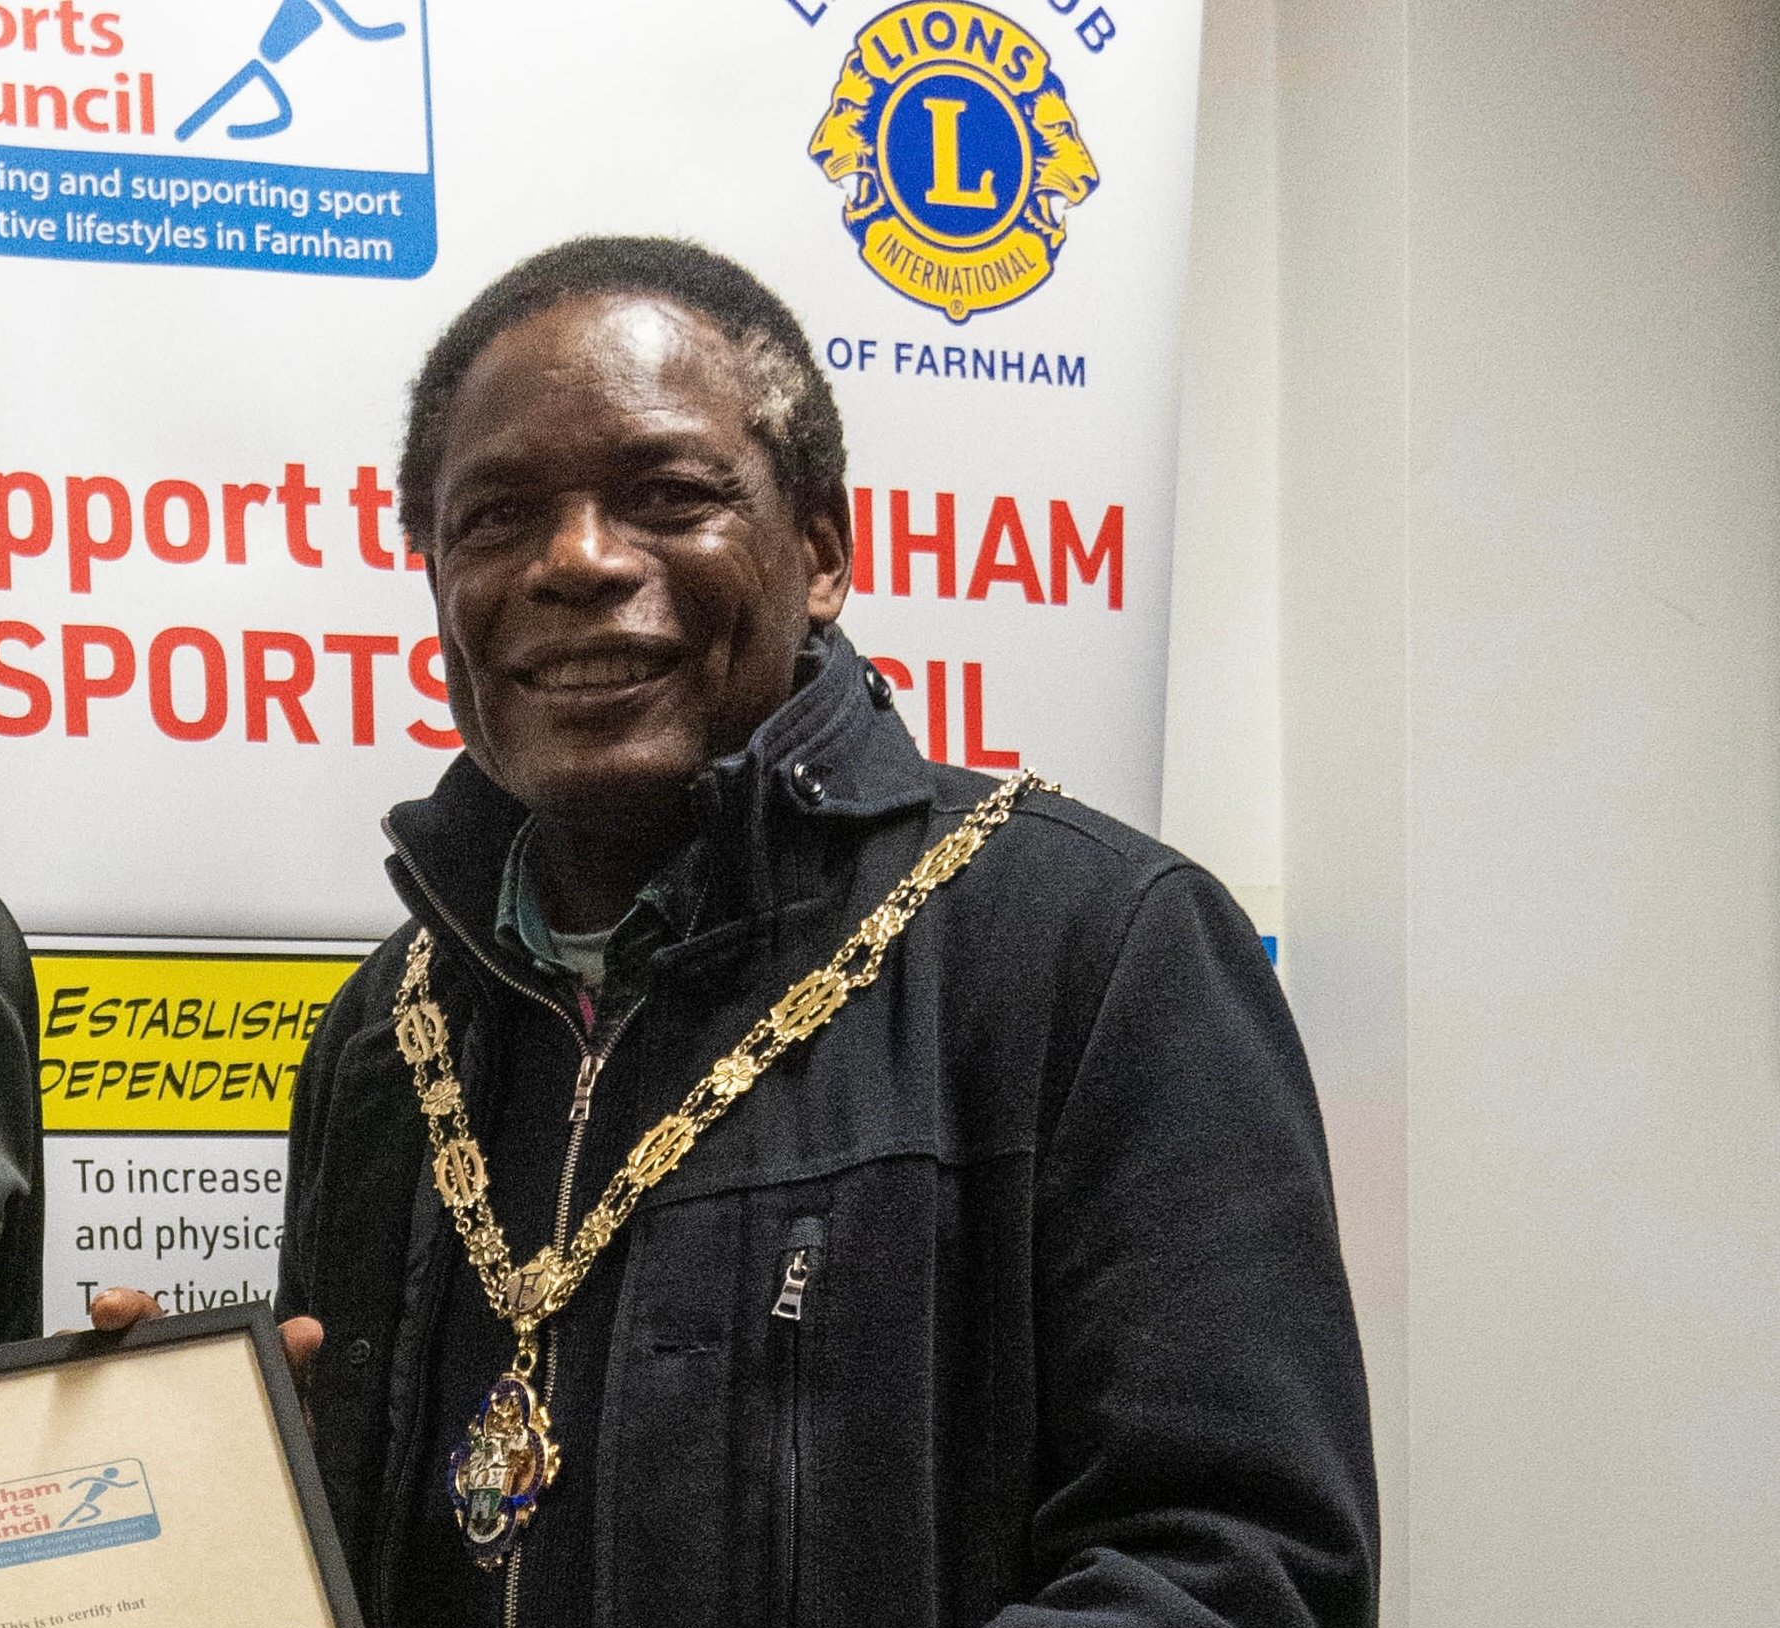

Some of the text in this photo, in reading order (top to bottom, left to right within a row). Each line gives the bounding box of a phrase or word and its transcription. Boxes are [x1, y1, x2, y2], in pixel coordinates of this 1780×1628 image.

[872, 10, 1034, 83] LIONS
[924, 99, 996, 209] L
[58, 166, 121, 199] and
[131, 172, 309, 215] supporting
[318, 187, 403, 219] sport
[65, 212, 208, 252] lifestyles
[216, 222, 247, 252] in
[255, 224, 394, 261] Farnham
[877, 232, 1036, 297] INTERNATIONAL
[826, 337, 1087, 388] OF FARNHAM
[73, 1160, 282, 1193] To increase
[76, 1217, 142, 1250] and
[49, 1612, 64, 1627] to
[67, 1604, 113, 1624] certify
[117, 1597, 146, 1614] that
